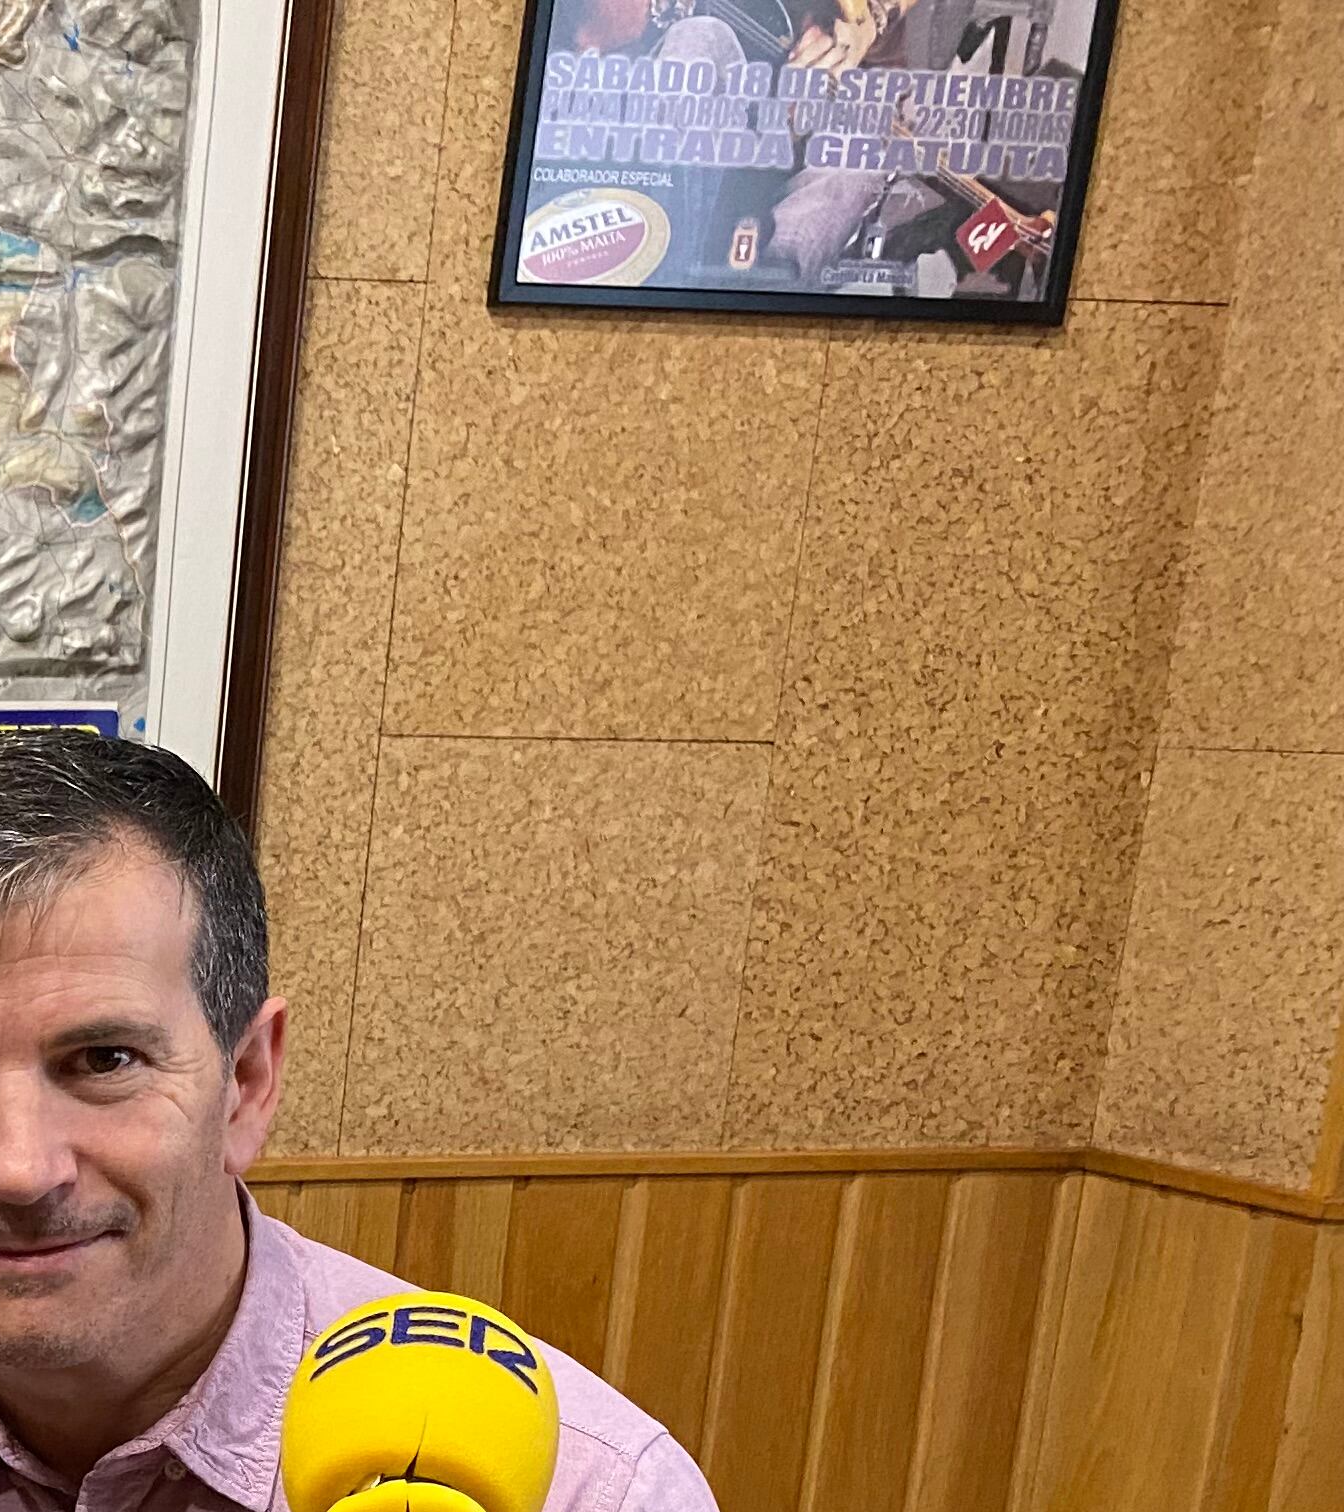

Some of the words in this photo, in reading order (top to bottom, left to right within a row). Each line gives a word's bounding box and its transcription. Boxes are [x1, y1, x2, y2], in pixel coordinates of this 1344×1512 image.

[548, 49, 716, 95] SÁBADO
[726, 62, 772, 98] 18
[781, 67, 831, 101] DE
[838, 69, 1077, 112] SEPTIEMBRE
[627, 91, 659, 125] DE
[664, 95, 749, 129] TOROS
[989, 110, 1073, 145] HORAS
[533, 168, 619, 185] COLABORADOR
[621, 171, 674, 187] ESPECIAL
[537, 124, 793, 167] ENTRADA
[807, 136, 1067, 179] GRATUITA
[531, 207, 633, 251] AMSTEL
[309, 1306, 539, 1396] SER
